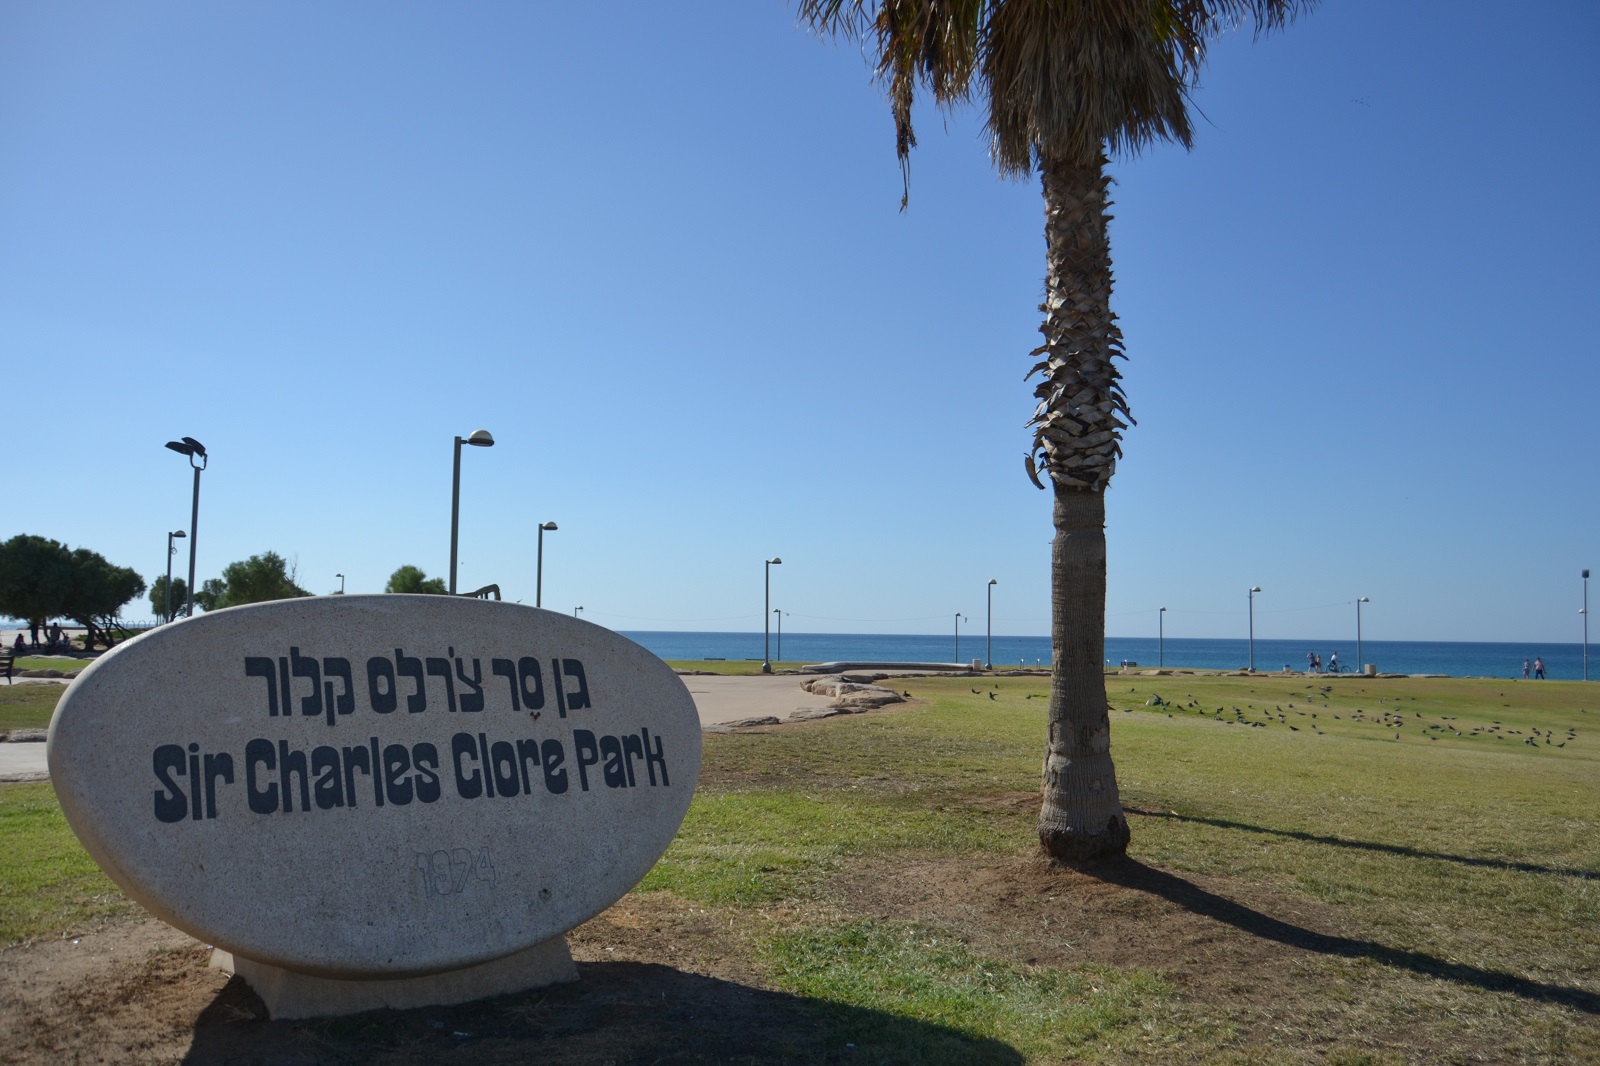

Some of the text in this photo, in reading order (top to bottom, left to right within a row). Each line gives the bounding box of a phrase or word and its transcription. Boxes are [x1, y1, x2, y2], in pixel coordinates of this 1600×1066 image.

[243, 645, 356, 728] קלור
[491, 656, 546, 712] סר
[551, 658, 592, 719] גן
[152, 726, 671, 824] Sir Charles Clore Park
[415, 845, 497, 899] 1974
